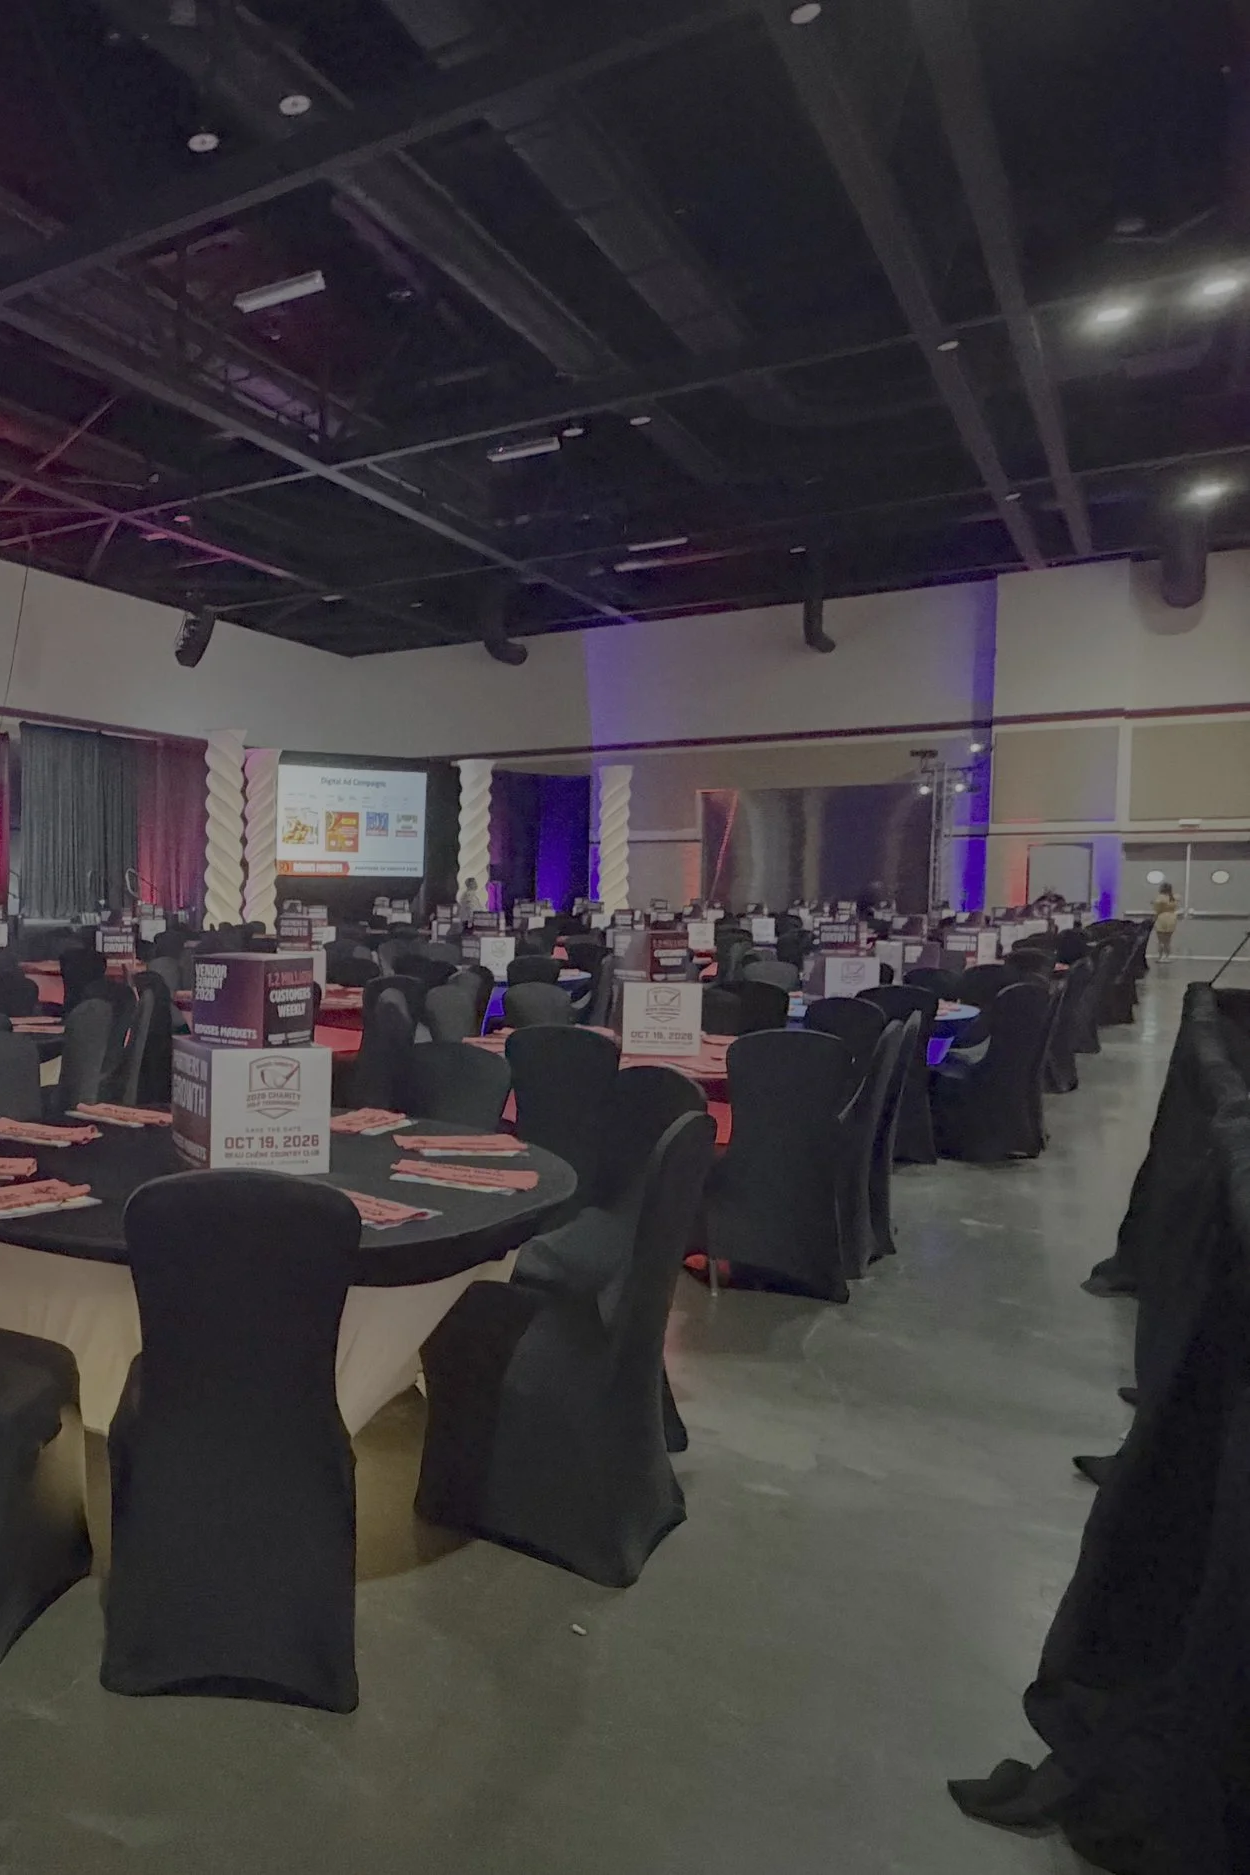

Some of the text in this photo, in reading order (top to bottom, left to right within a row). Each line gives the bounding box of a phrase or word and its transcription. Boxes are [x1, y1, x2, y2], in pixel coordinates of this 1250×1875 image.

[320, 776, 342, 787] Digital
[195, 964, 227, 979] VENDOR
[195, 976, 224, 989] SUMMIT
[267, 972, 280, 987] 1.2
[195, 987, 216, 1001] 2026
[269, 987, 312, 1003] CUSTOMERS
[277, 1002, 306, 1018] WEEKLY
[220, 1026, 257, 1040] MARKETS
[630, 1031, 650, 1040] OCT
[173, 1074, 207, 1118] GROWTH
[268, 1091, 301, 1100] CHARITY
[224, 1134, 320, 1150] OCT 19, 2026
[224, 1151, 245, 1159] BEAU
[270, 1150, 301, 1158] COUNTRY
[302, 1148, 320, 1157] CLUB
